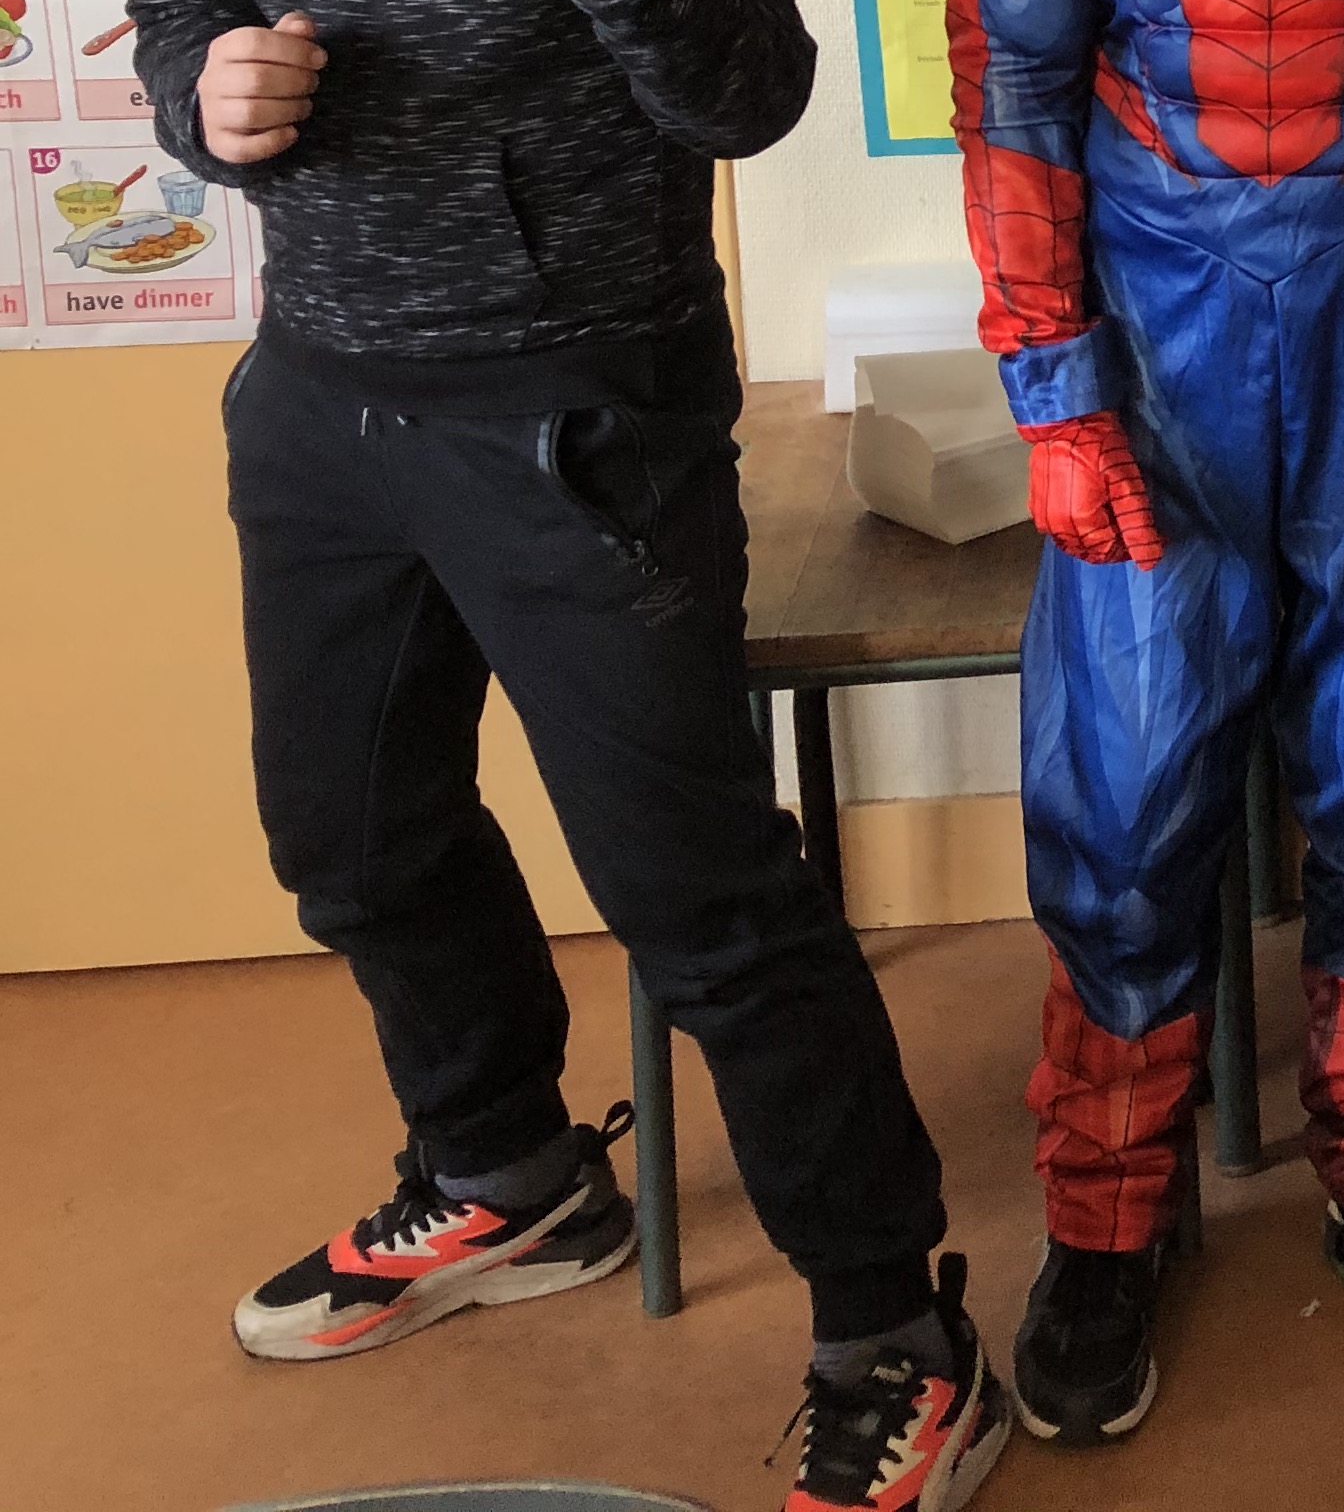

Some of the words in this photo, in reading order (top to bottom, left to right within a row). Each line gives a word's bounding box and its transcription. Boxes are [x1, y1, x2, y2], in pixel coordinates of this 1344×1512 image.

[32, 152, 58, 169] 16
[66, 291, 125, 312] have
[134, 288, 215, 311] dinner
